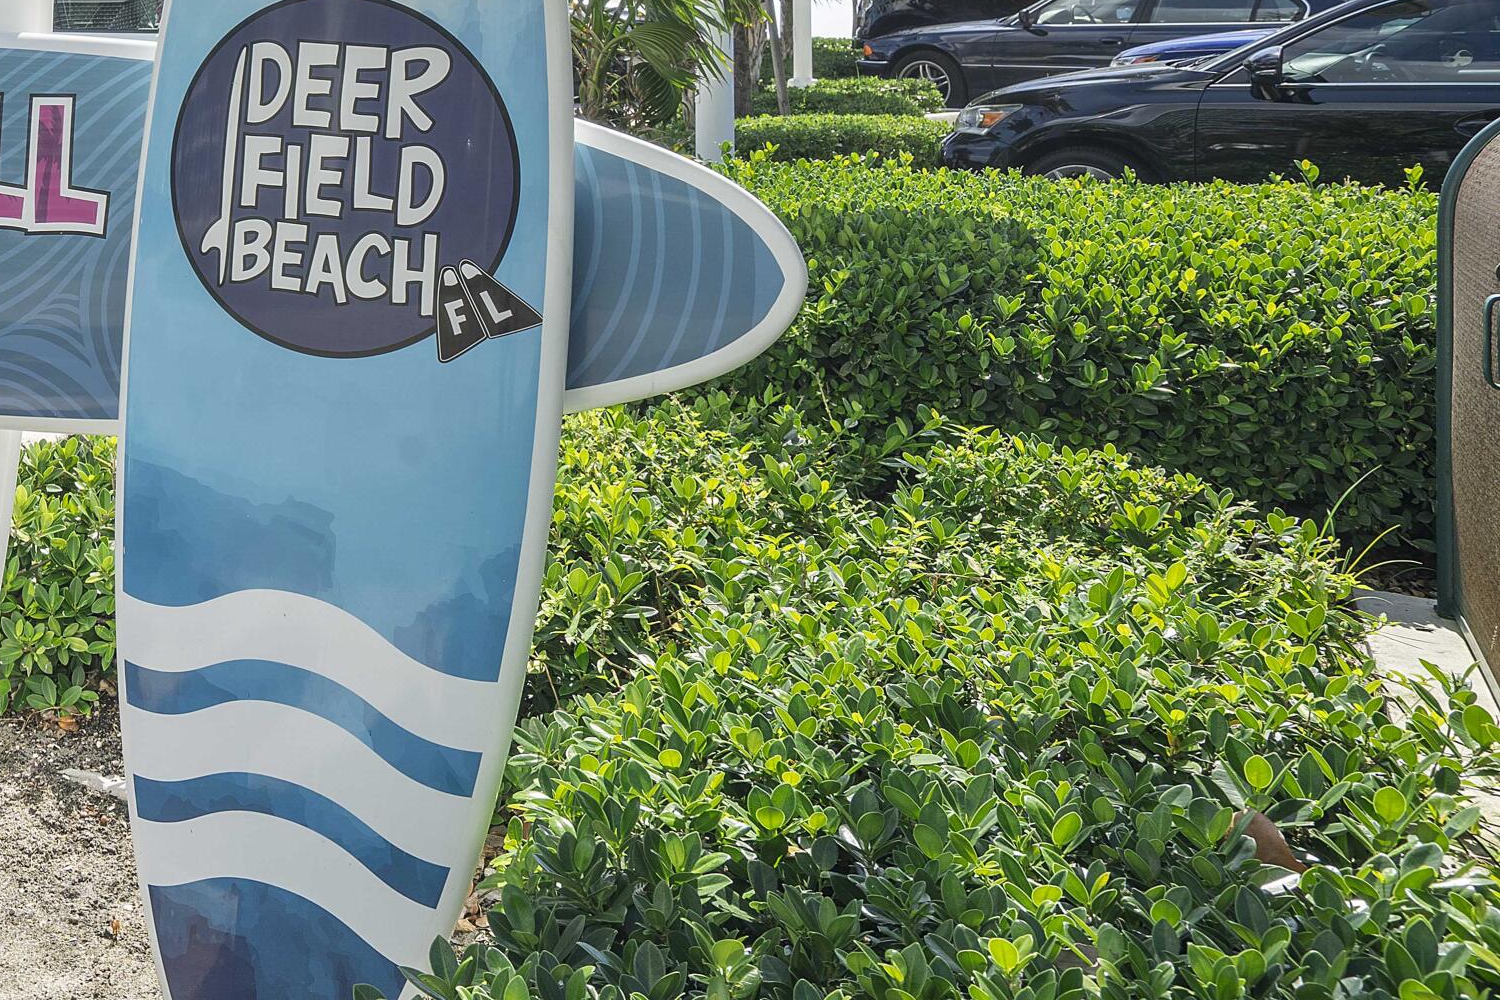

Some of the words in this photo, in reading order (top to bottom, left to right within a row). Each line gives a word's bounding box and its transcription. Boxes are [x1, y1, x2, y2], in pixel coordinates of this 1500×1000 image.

[245, 40, 452, 140] DEER
[239, 133, 446, 227] FIELD
[230, 217, 441, 317] BEACH
[443, 289, 514, 336] FL
